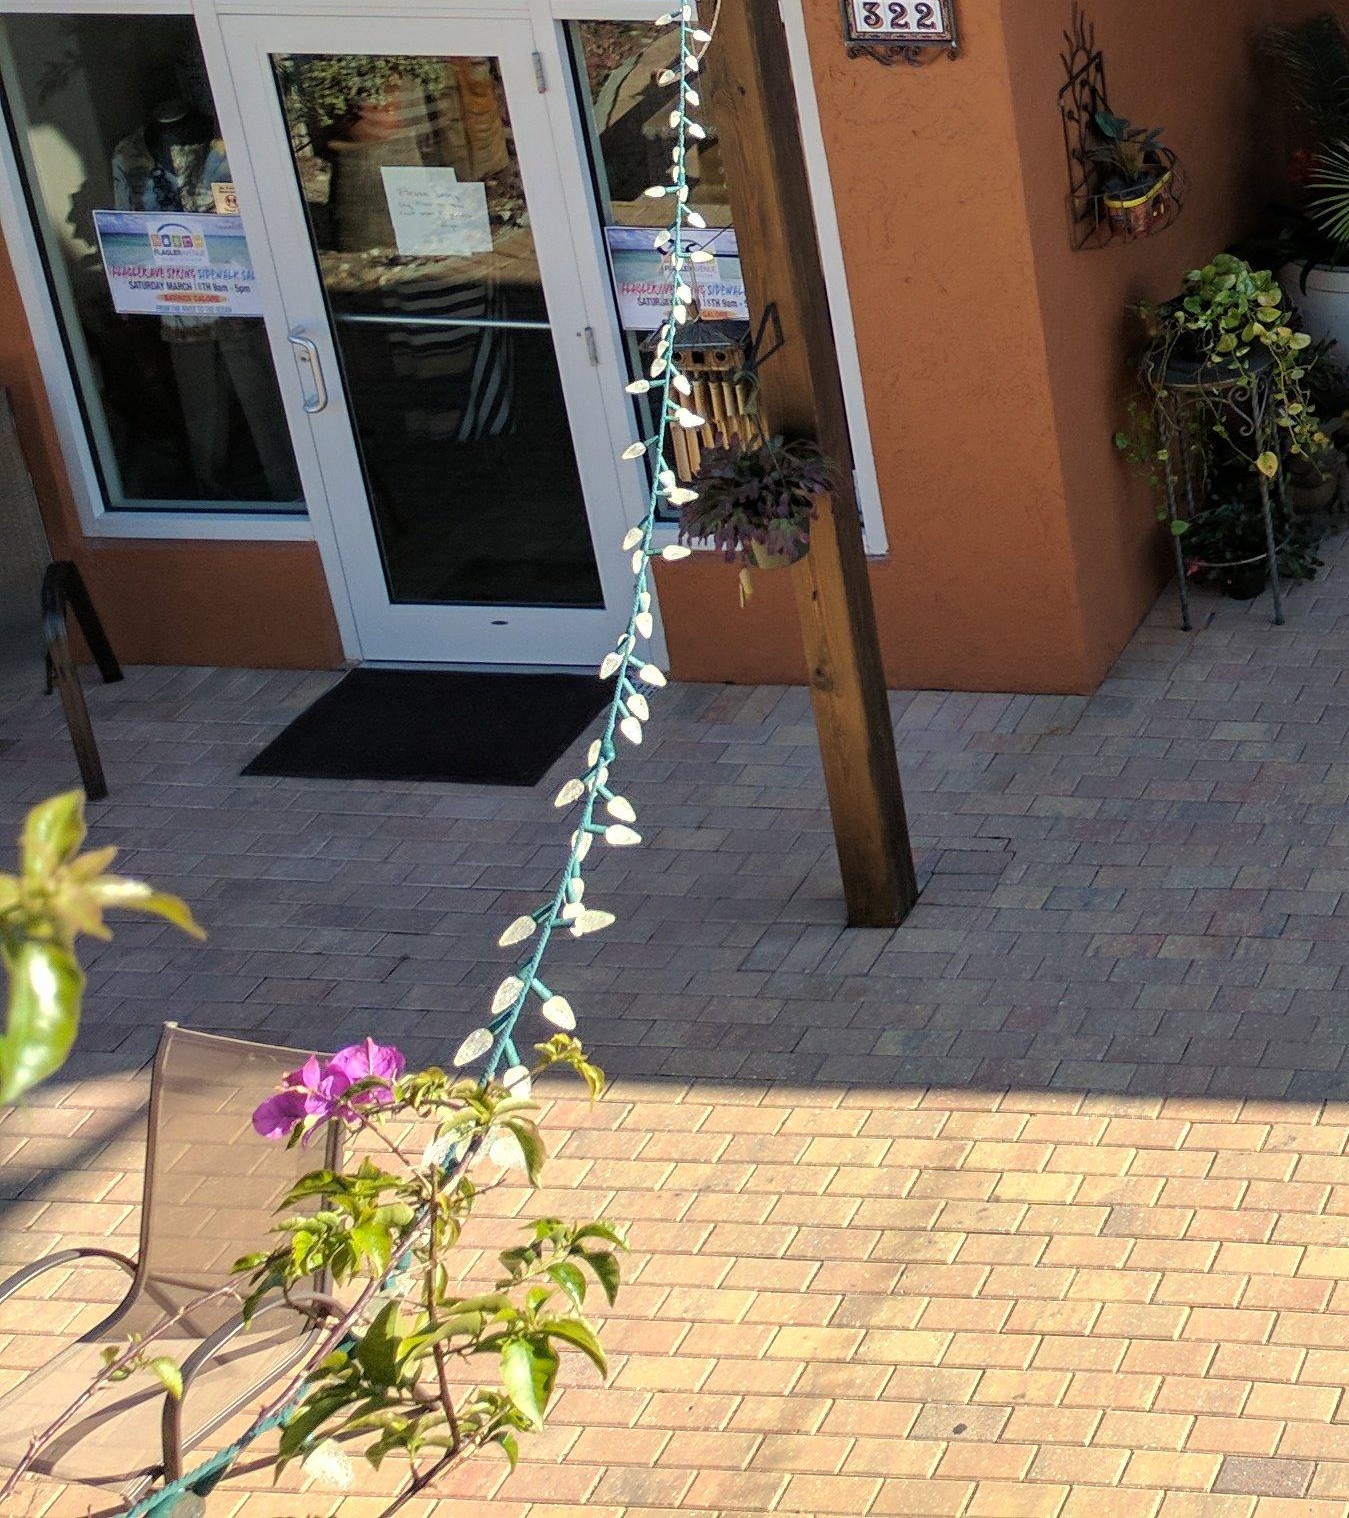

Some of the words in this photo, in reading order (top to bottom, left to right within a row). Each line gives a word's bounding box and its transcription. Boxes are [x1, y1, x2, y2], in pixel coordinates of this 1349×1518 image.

[862, 1, 938, 31] 322
[129, 281, 164, 290] SATURDAY
[166, 281, 193, 290] MARCH
[234, 283, 251, 294] 5pm
[707, 284, 745, 297] SIDEWAL
